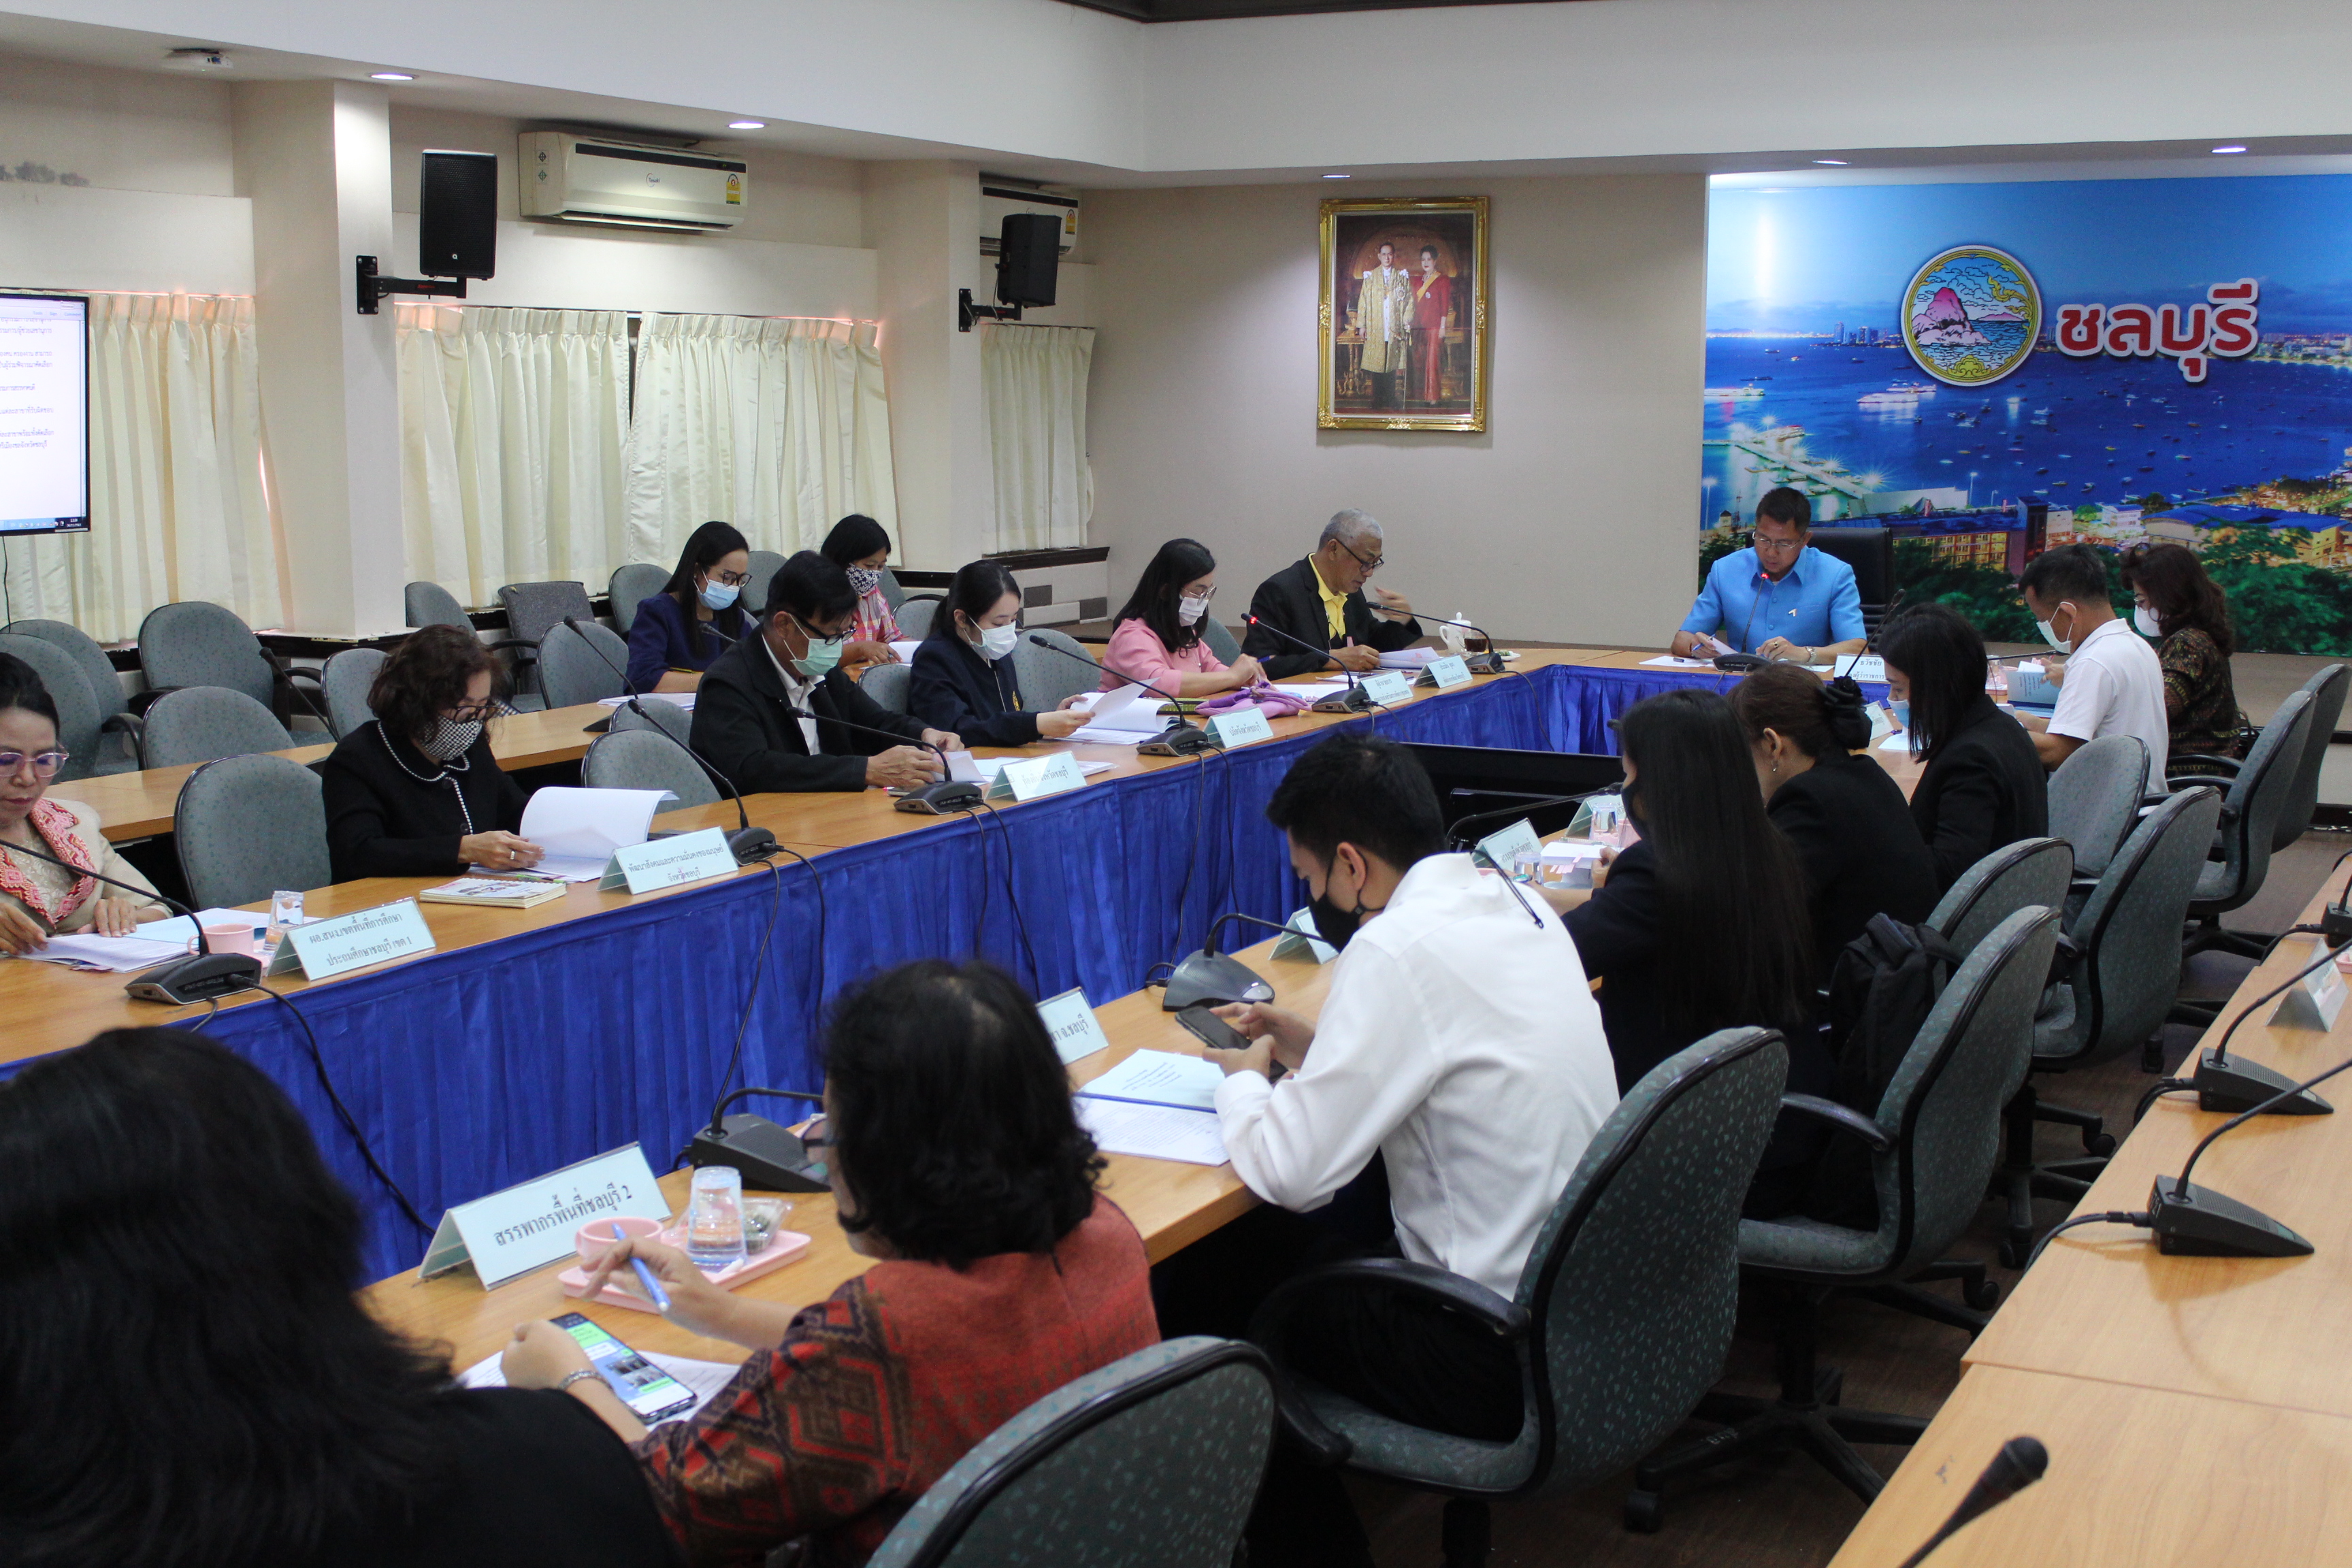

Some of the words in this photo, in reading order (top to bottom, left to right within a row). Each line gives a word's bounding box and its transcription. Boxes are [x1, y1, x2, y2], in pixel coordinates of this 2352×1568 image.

[2056, 278, 2259, 382] ชลบุรี
[326, 937, 392, 967] ประถมศึกษาชลบุรี
[1061, 1013, 1090, 1039] จ.ชลบุรี
[493, 1181, 622, 1247] สรรพากรพื้นที่ชลบุรี
[622, 1184, 633, 1200] 2
